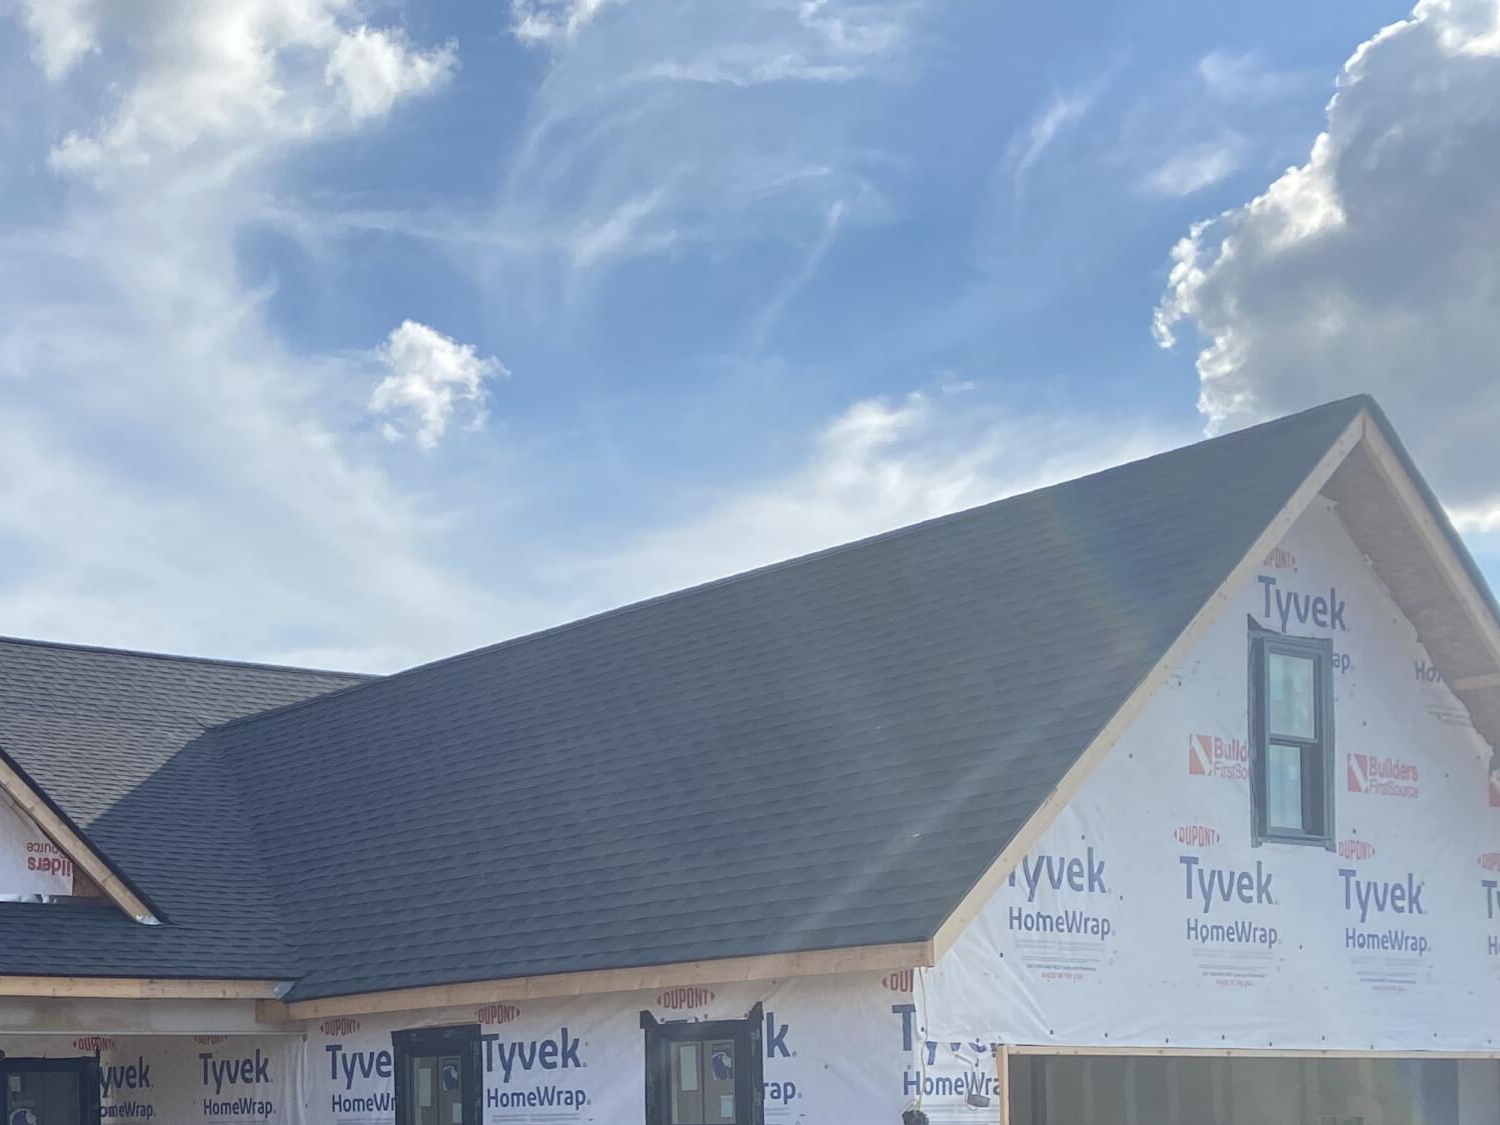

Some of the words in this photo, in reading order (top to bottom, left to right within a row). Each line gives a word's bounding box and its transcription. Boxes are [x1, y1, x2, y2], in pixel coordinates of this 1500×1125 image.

[1258, 575, 1346, 633] Tyvek
[1214, 736, 1247, 761] Build
[1369, 756, 1419, 781] Builders
[1179, 825, 1216, 848] DUPONT
[27, 856, 71, 877] ilders
[1179, 855, 1274, 914] Tyvek
[1338, 868, 1423, 923] Tyvek
[1008, 906, 1111, 940] HomeWrap
[1186, 918, 1278, 949] HomeWrap
[1345, 927, 1427, 956] HomeWrap
[664, 988, 709, 1010] DUPONT
[324, 1017, 357, 1037] DUPONT
[478, 1004, 515, 1025] DUPONT
[325, 1044, 392, 1089] Tyve
[481, 1027, 582, 1083] Tyvek
[100, 1056, 150, 1098] yvek
[199, 1049, 269, 1094] Tyvek
[903, 1071, 1000, 1095] HomeWra
[204, 1098, 273, 1119] HomeWrap
[331, 1093, 396, 1113] HomeWr
[487, 1085, 587, 1110] HomeWrap
[100, 1101, 154, 1120] omeWrap
